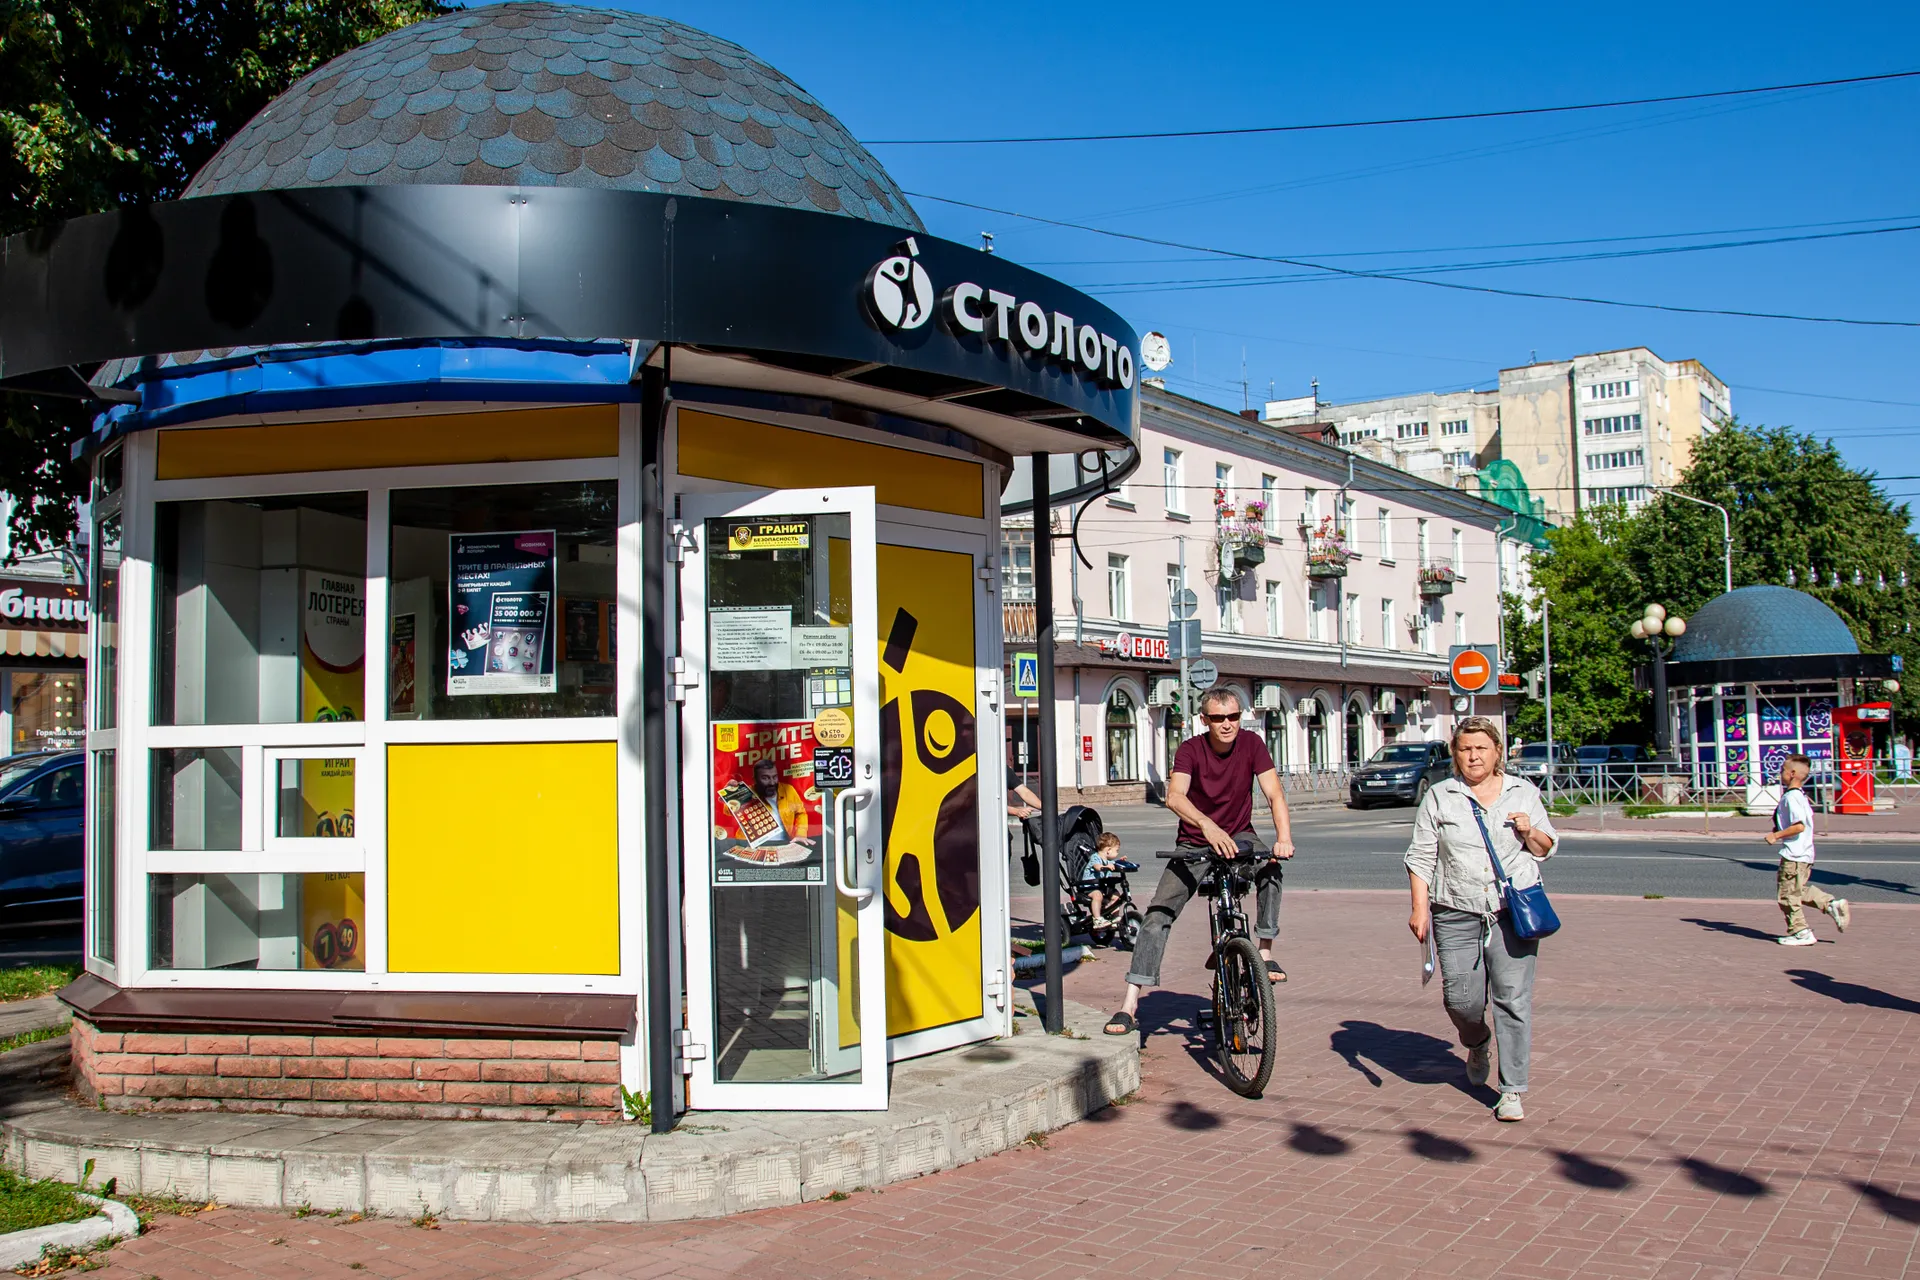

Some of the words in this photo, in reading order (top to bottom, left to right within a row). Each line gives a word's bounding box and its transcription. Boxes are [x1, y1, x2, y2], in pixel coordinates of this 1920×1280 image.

[953, 282, 1133, 389] СТОЛОТО
[759, 524, 805, 534] ГРАНИТ
[457, 563, 482, 571] ТРИТЕ
[490, 561, 546, 570] ПРАВИЛЬНЫХ
[457, 572, 490, 580] МЕСТАХ!
[321, 578, 355, 594] ГЛАВНАЯ
[308, 591, 365, 617] ЛОТЕРЕЯ
[326, 616, 350, 626] СТРАНЫ
[1135, 638, 1170, 658] СОЮ
[1762, 706, 1792, 720] SKY
[746, 724, 813, 748] ТРИТЕ
[1763, 721, 1793, 736] PAR
[734, 742, 802, 767] ТРИТЕ
[342, 818, 353, 837] 45
